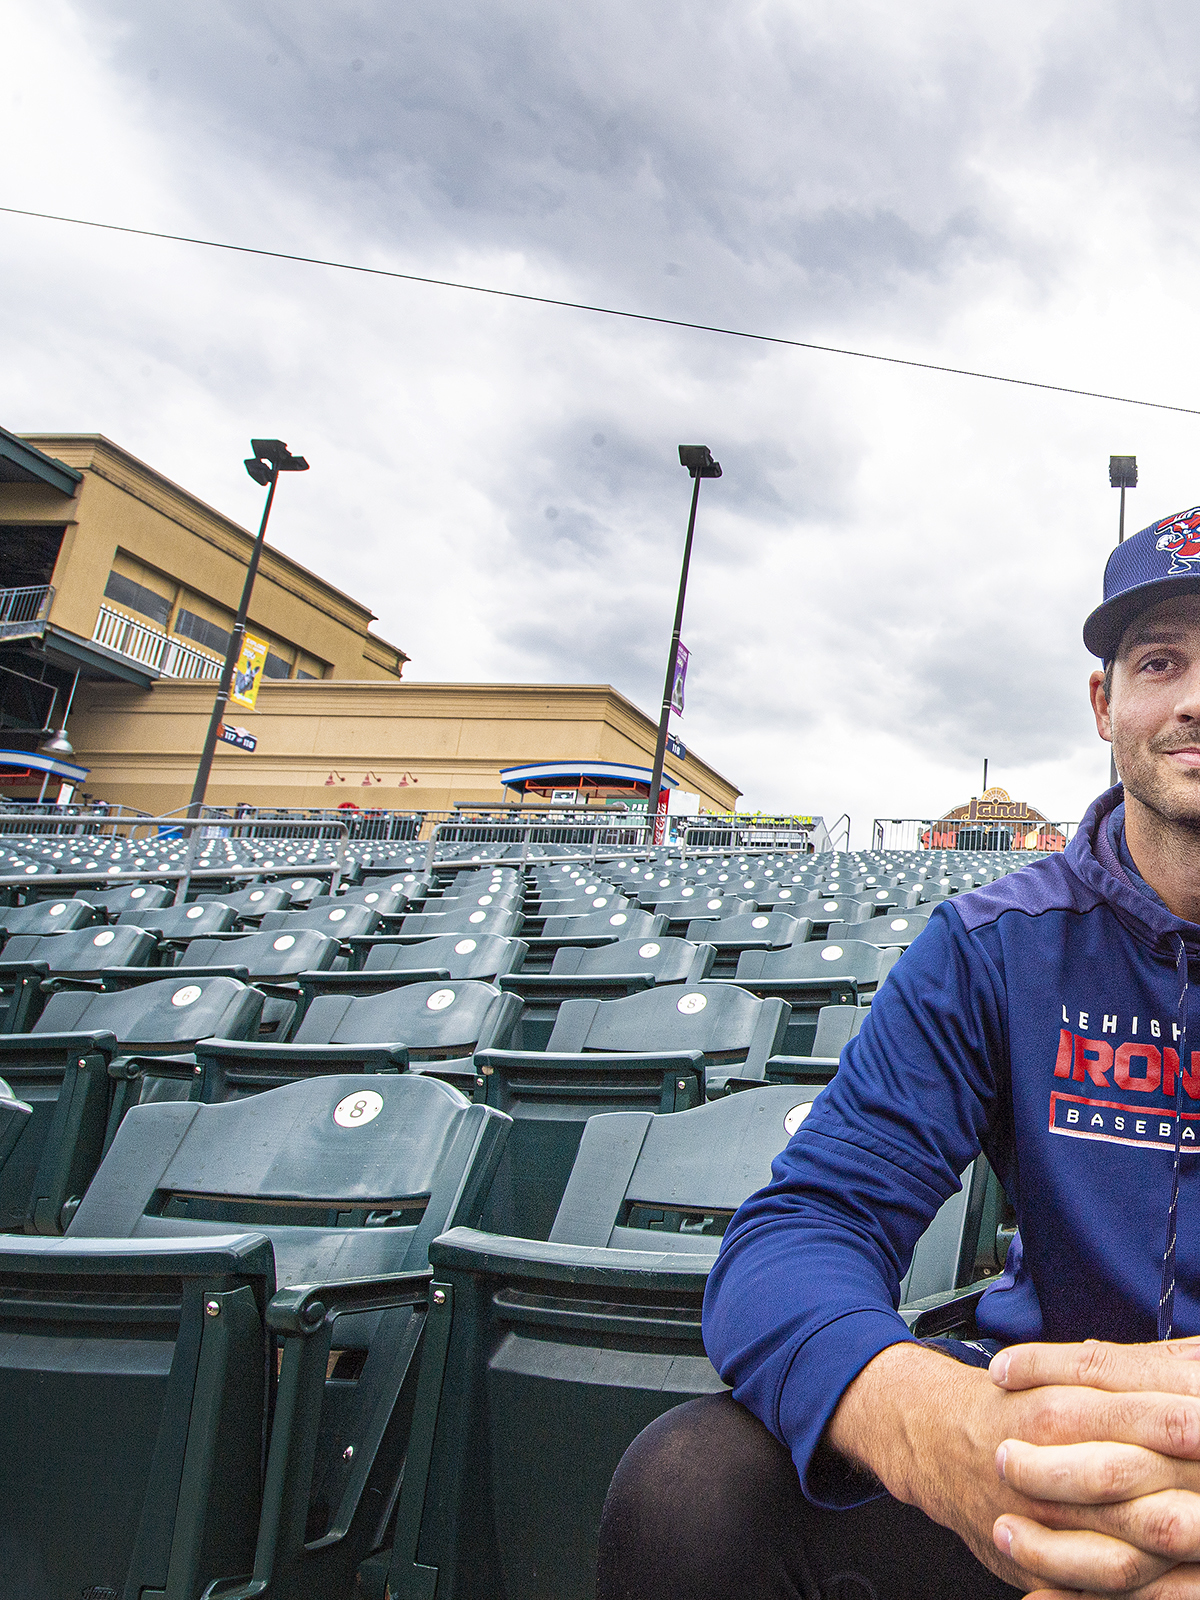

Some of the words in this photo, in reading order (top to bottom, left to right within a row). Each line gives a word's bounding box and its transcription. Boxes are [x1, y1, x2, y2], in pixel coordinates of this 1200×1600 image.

[961, 800, 1029, 823] Jaindl
[182, 991, 192, 1001] 6
[438, 995, 446, 1004] 7
[687, 999, 697, 1008] 8
[1062, 1004, 1185, 1042] LEHIGH
[349, 1100, 367, 1118] 8
